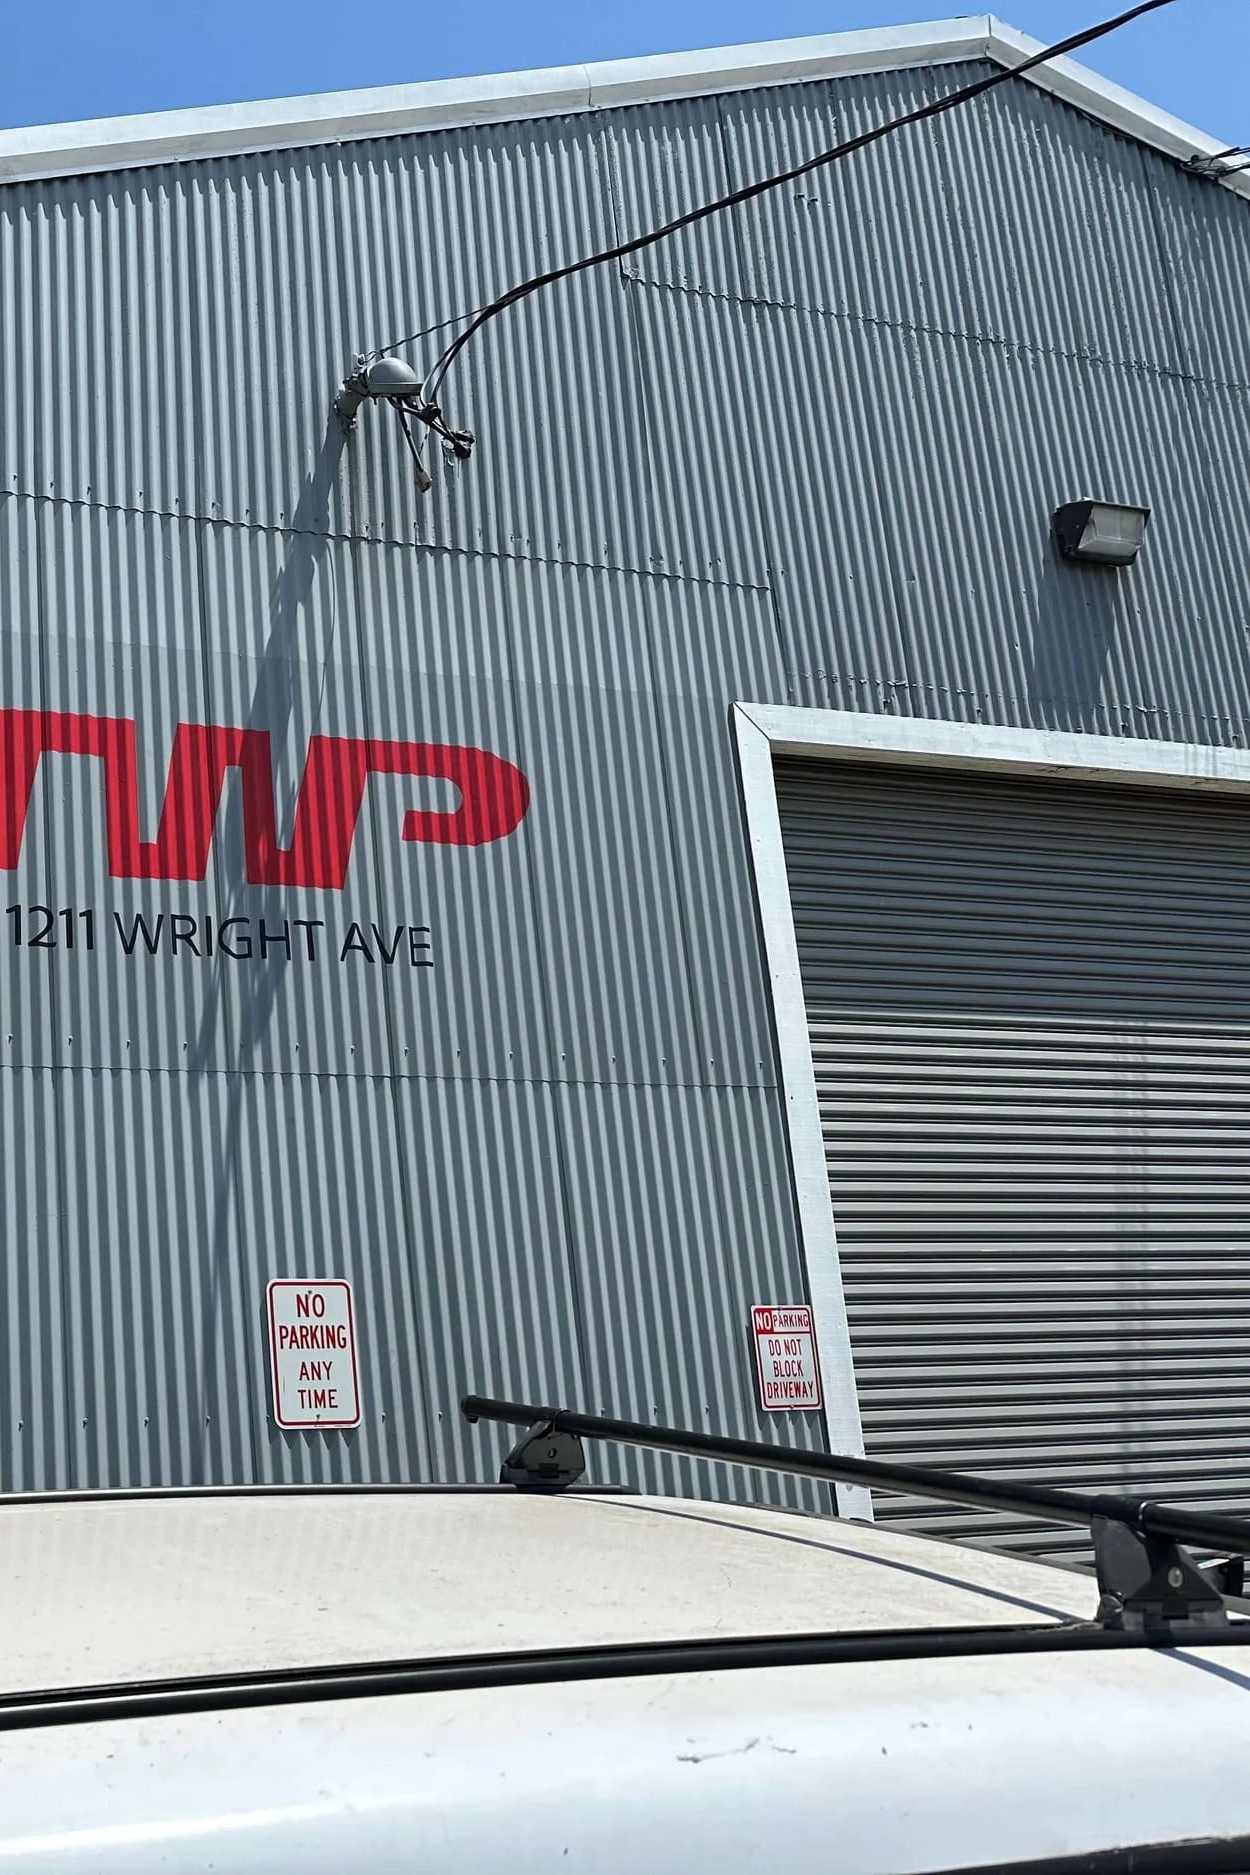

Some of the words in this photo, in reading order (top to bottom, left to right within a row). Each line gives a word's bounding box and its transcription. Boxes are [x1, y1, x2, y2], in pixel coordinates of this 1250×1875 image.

[6, 905, 94, 950] 1211
[113, 912, 324, 962] WRIGHT
[340, 922, 434, 967] AVE
[296, 1293, 325, 1318] NO
[755, 1312, 772, 1330] NO
[773, 1314, 809, 1327] PARKING
[279, 1325, 347, 1349] PARKING
[768, 1339, 782, 1356] DO
[784, 1339, 802, 1356] NOT
[299, 1361, 333, 1381] ANY
[773, 1360, 804, 1378] BLOCK
[297, 1389, 339, 1409] TIME
[767, 1381, 814, 1399] DRIVEWAY
